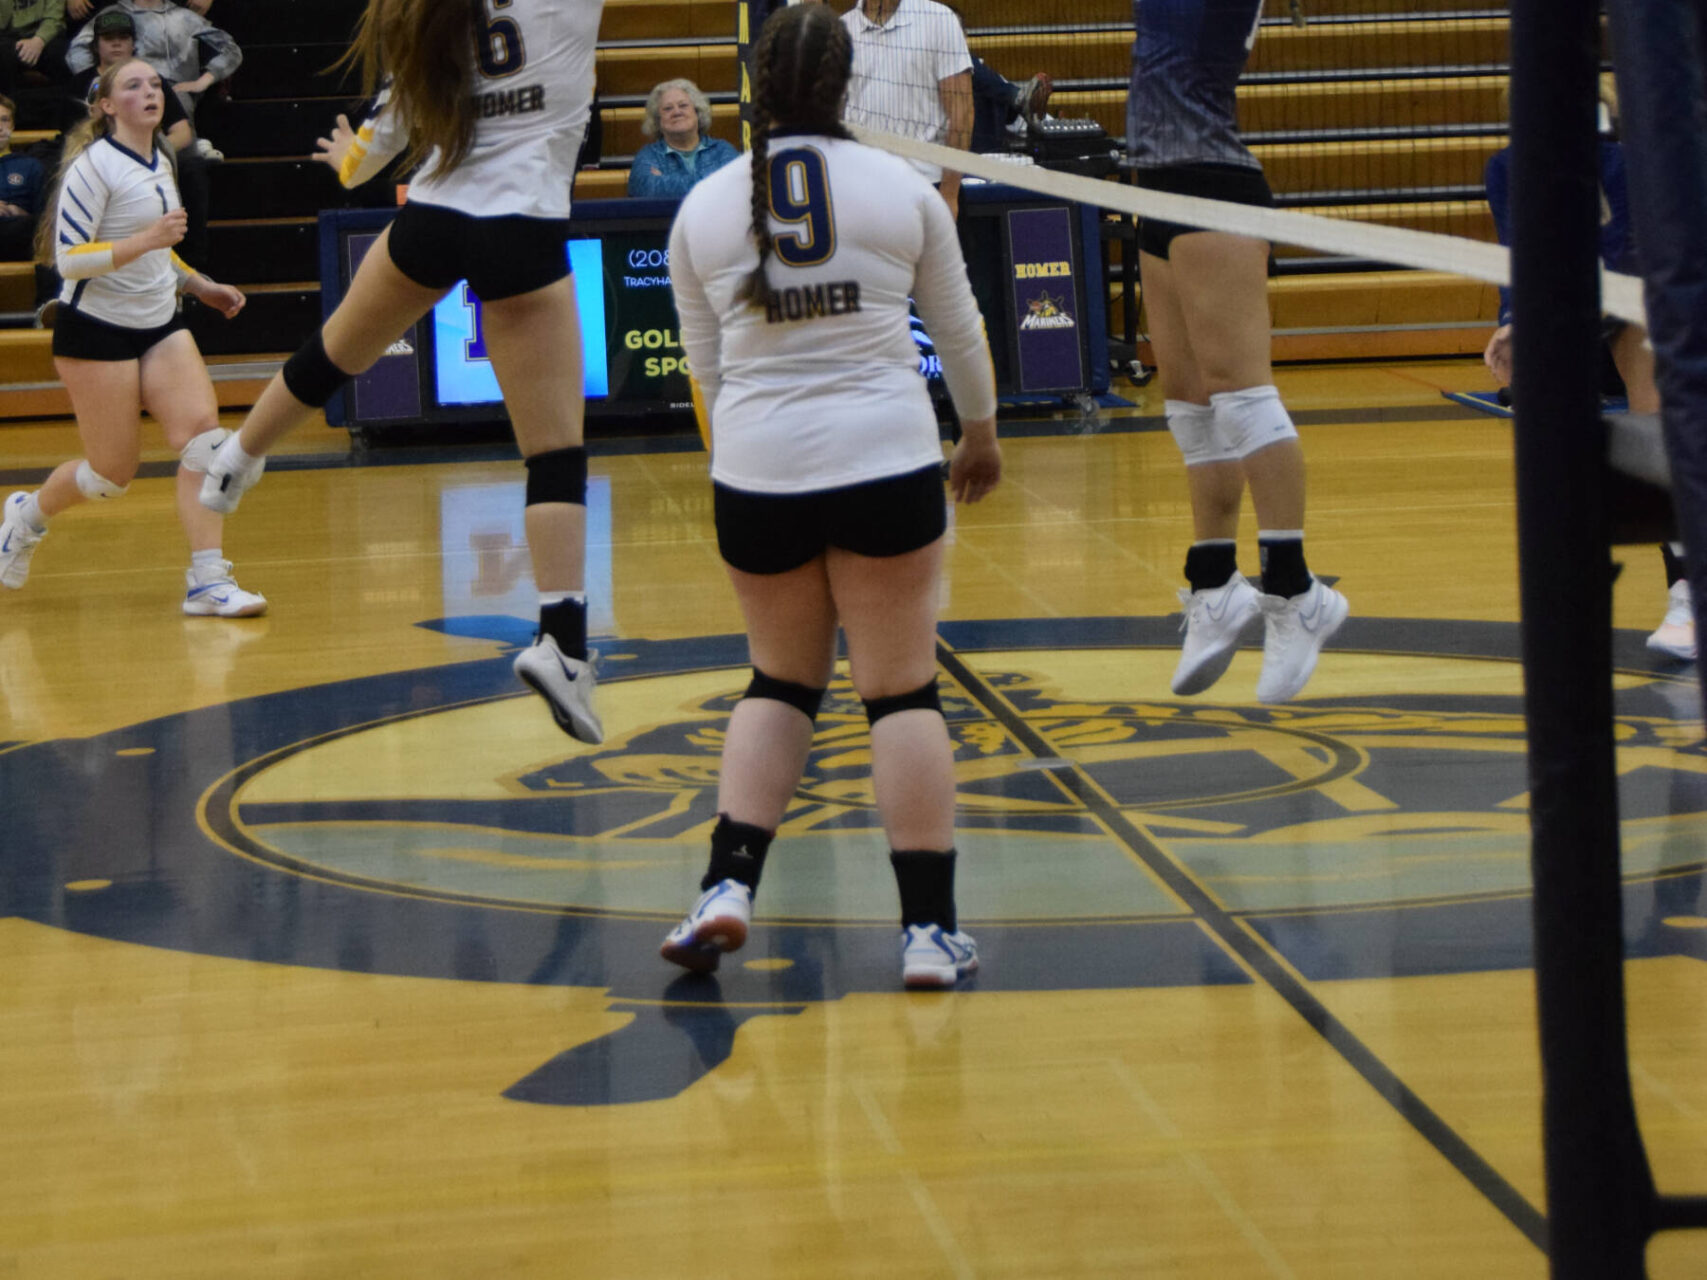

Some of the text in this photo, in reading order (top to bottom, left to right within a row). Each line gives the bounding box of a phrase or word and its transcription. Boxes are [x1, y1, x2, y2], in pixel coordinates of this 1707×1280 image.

[768, 144, 837, 268] 9
[1015, 261, 1072, 279] HOMER
[767, 281, 862, 324] HOMER
